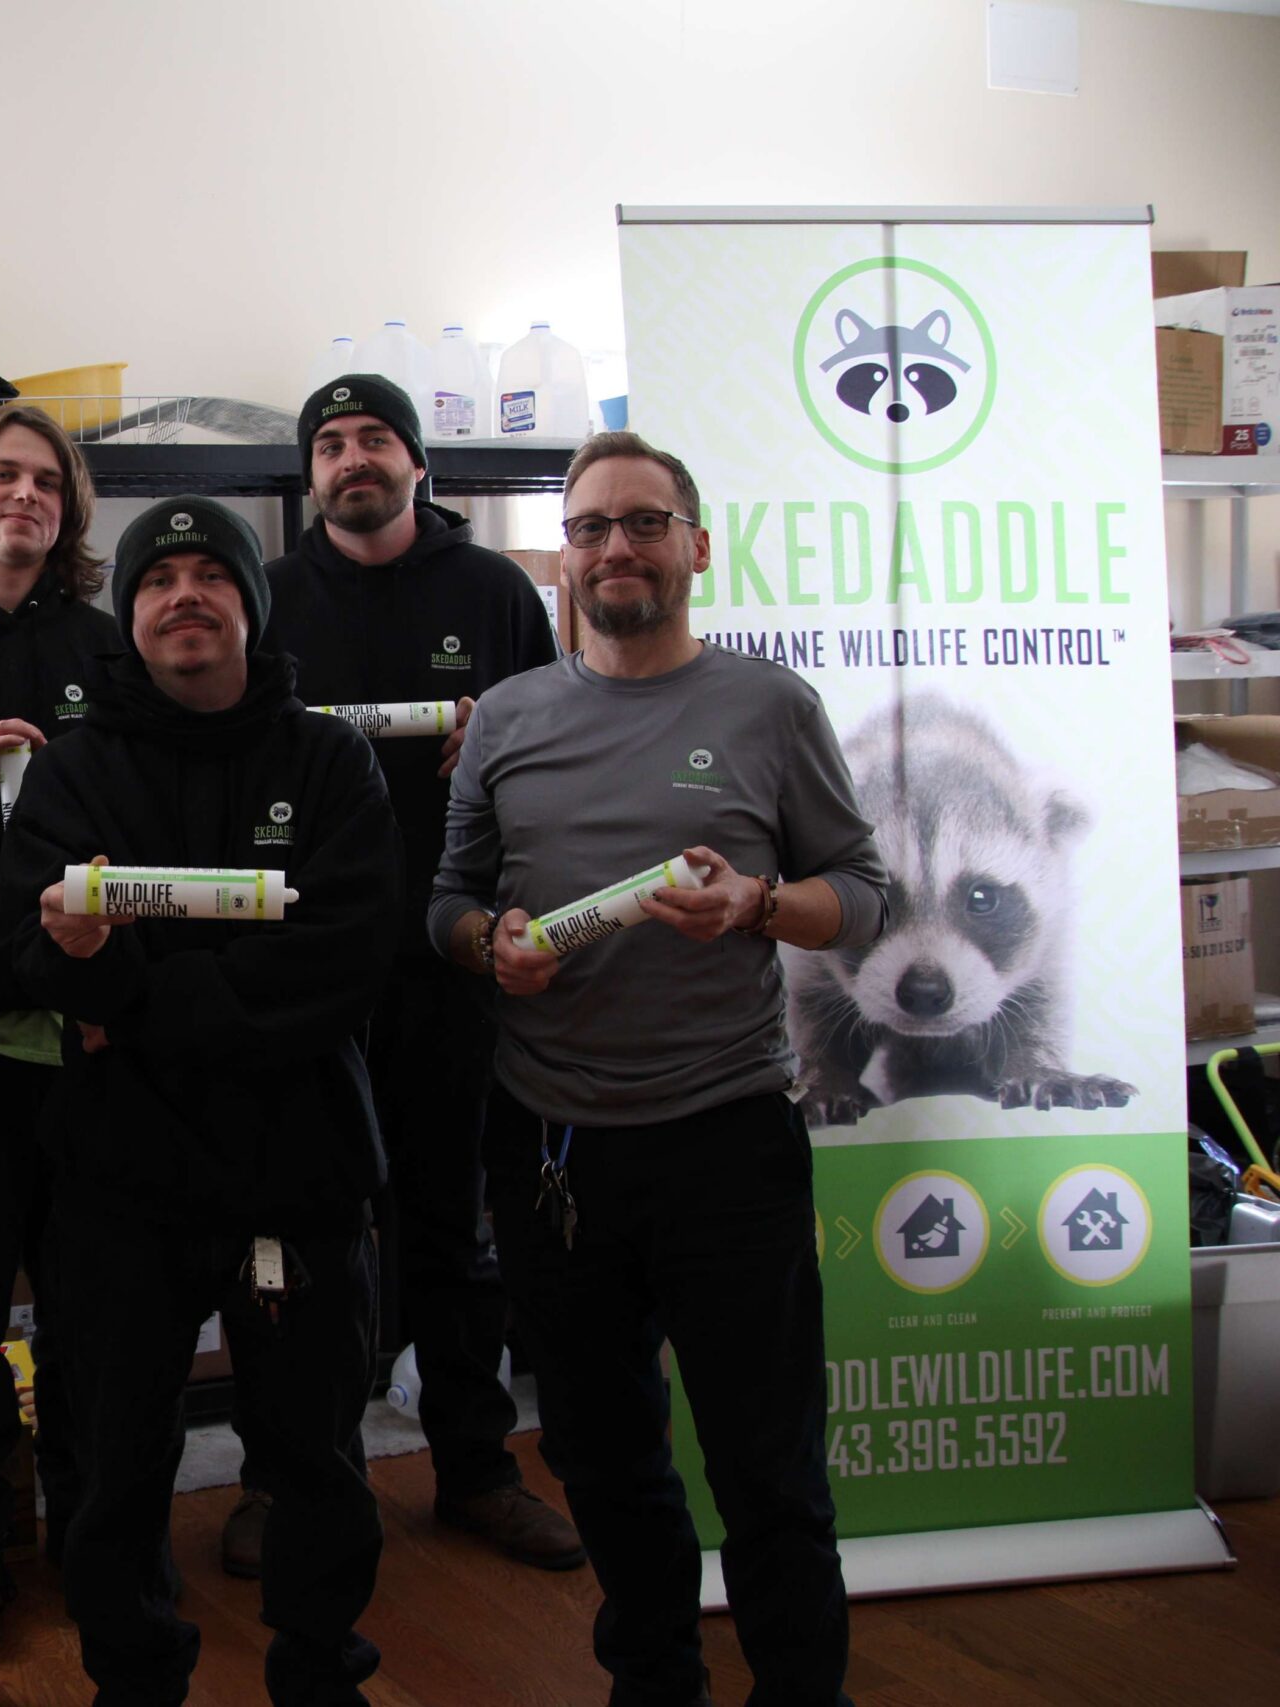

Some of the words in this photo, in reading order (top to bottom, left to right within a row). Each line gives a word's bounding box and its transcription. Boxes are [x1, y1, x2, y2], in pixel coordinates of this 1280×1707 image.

[321, 401, 364, 417] SKEDADDLE
[509, 403, 529, 414] MILK
[1234, 429, 1249, 441] 25
[155, 531, 209, 547] SKEDADDLE
[839, 627, 969, 668] WILDLIFE
[431, 652, 472, 665] SKEDADDLE
[334, 704, 382, 716] WILDLIFE
[339, 713, 392, 728] CLUSION
[105, 881, 173, 905] WILDLIFE
[106, 901, 188, 918] EXCLUSION
[545, 905, 602, 943] WILDLIFE
[553, 917, 625, 955] EXCLUSION
[922, 1313, 943, 1327] AND
[1041, 1307, 1083, 1321] PREVENT
[1087, 1306, 1106, 1319] AND
[1111, 1304, 1153, 1318] PROTECT
[827, 1411, 1069, 1478] 43.396.5592
